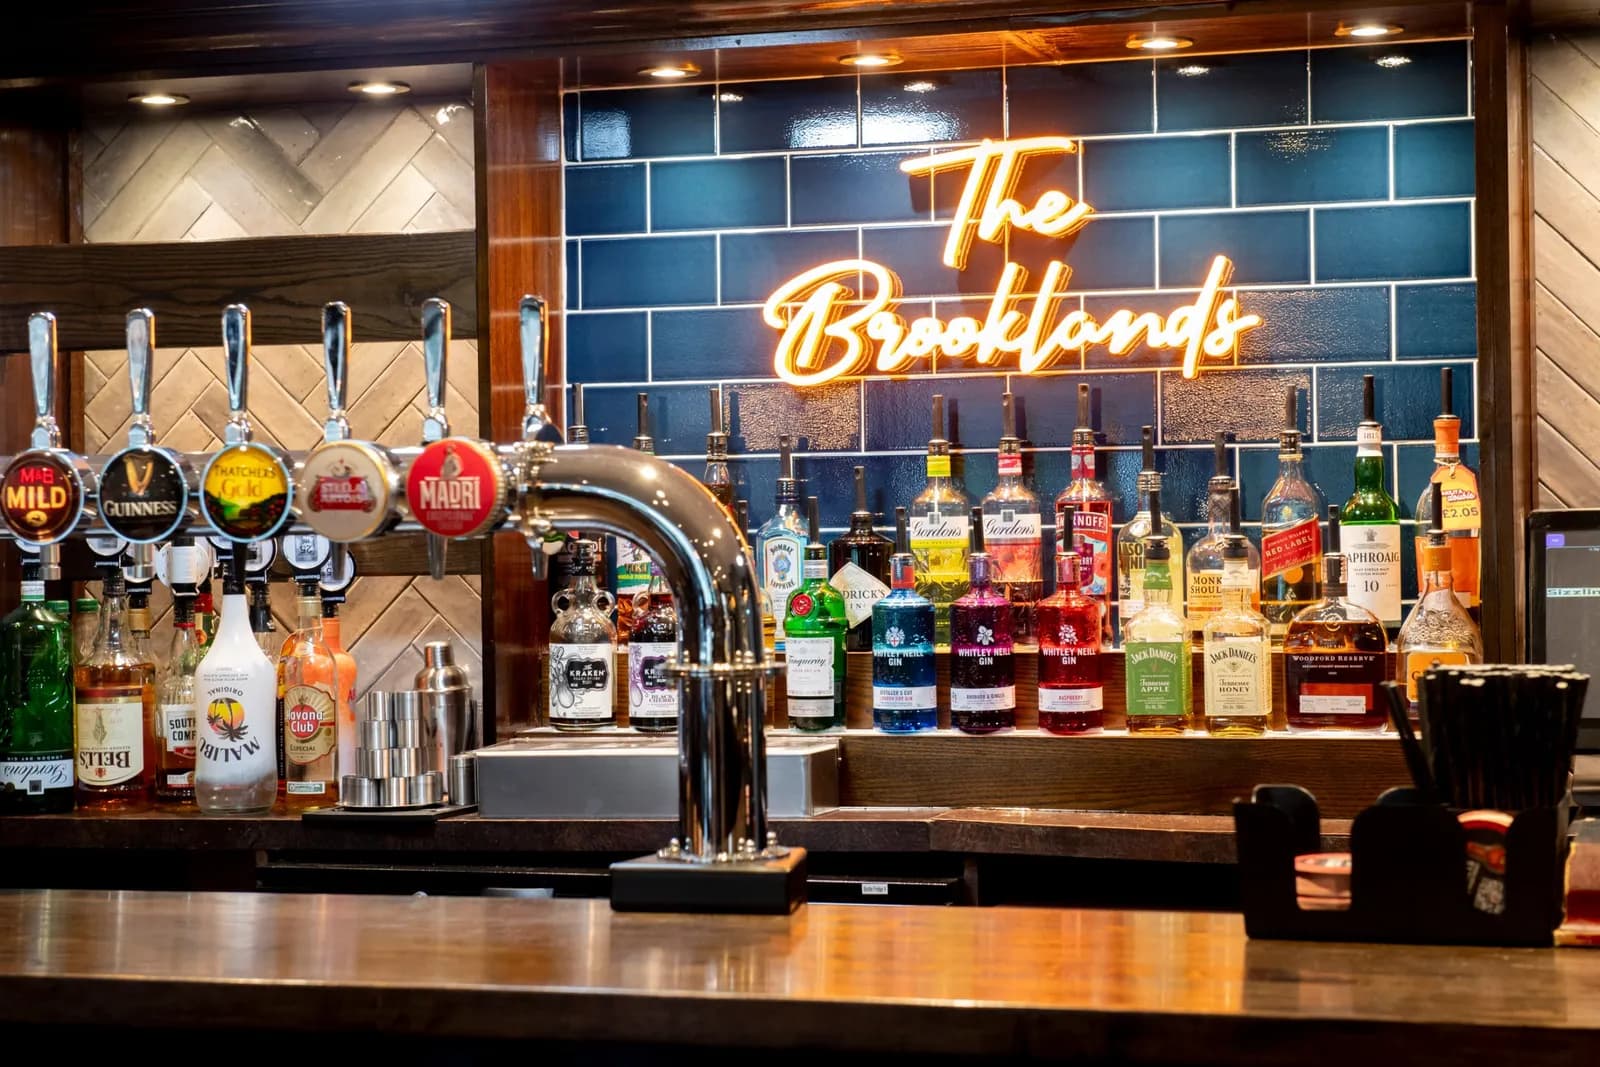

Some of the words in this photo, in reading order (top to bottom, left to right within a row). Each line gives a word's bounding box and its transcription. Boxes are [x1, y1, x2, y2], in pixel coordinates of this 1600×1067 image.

[899, 136, 1095, 271] The
[762, 254, 1264, 387] Brooklands
[214, 464, 277, 480] THATCHERS
[221, 479, 263, 499] Gold
[6, 486, 67, 510] MILD
[104, 500, 177, 517] GUINNESS
[1443, 506, 1479, 519] £2.05
[911, 520, 961, 538] Gordon's
[985, 519, 1035, 536] Gordon's
[1265, 546, 1283, 558] RED
[1284, 535, 1313, 550] LABEL
[1364, 580, 1380, 593] 10
[958, 648, 992, 657] WHITLEY
[1042, 647, 1075, 656] WHITLEY
[1077, 647, 1096, 656] NEILL
[1130, 650, 1149, 665] JACK
[1210, 650, 1228, 665] JACK
[1228, 647, 1258, 664] DANIEL'S
[888, 657, 902, 666] GIN
[978, 657, 993, 666] GIN
[1061, 656, 1077, 665] GIN
[207, 686, 244, 697] ORIGINAL
[291, 720, 315, 734] Club
[200, 736, 261, 764] MALIBU
[80, 750, 131, 770] BELL'S
[3, 763, 68, 785] Gordon's
